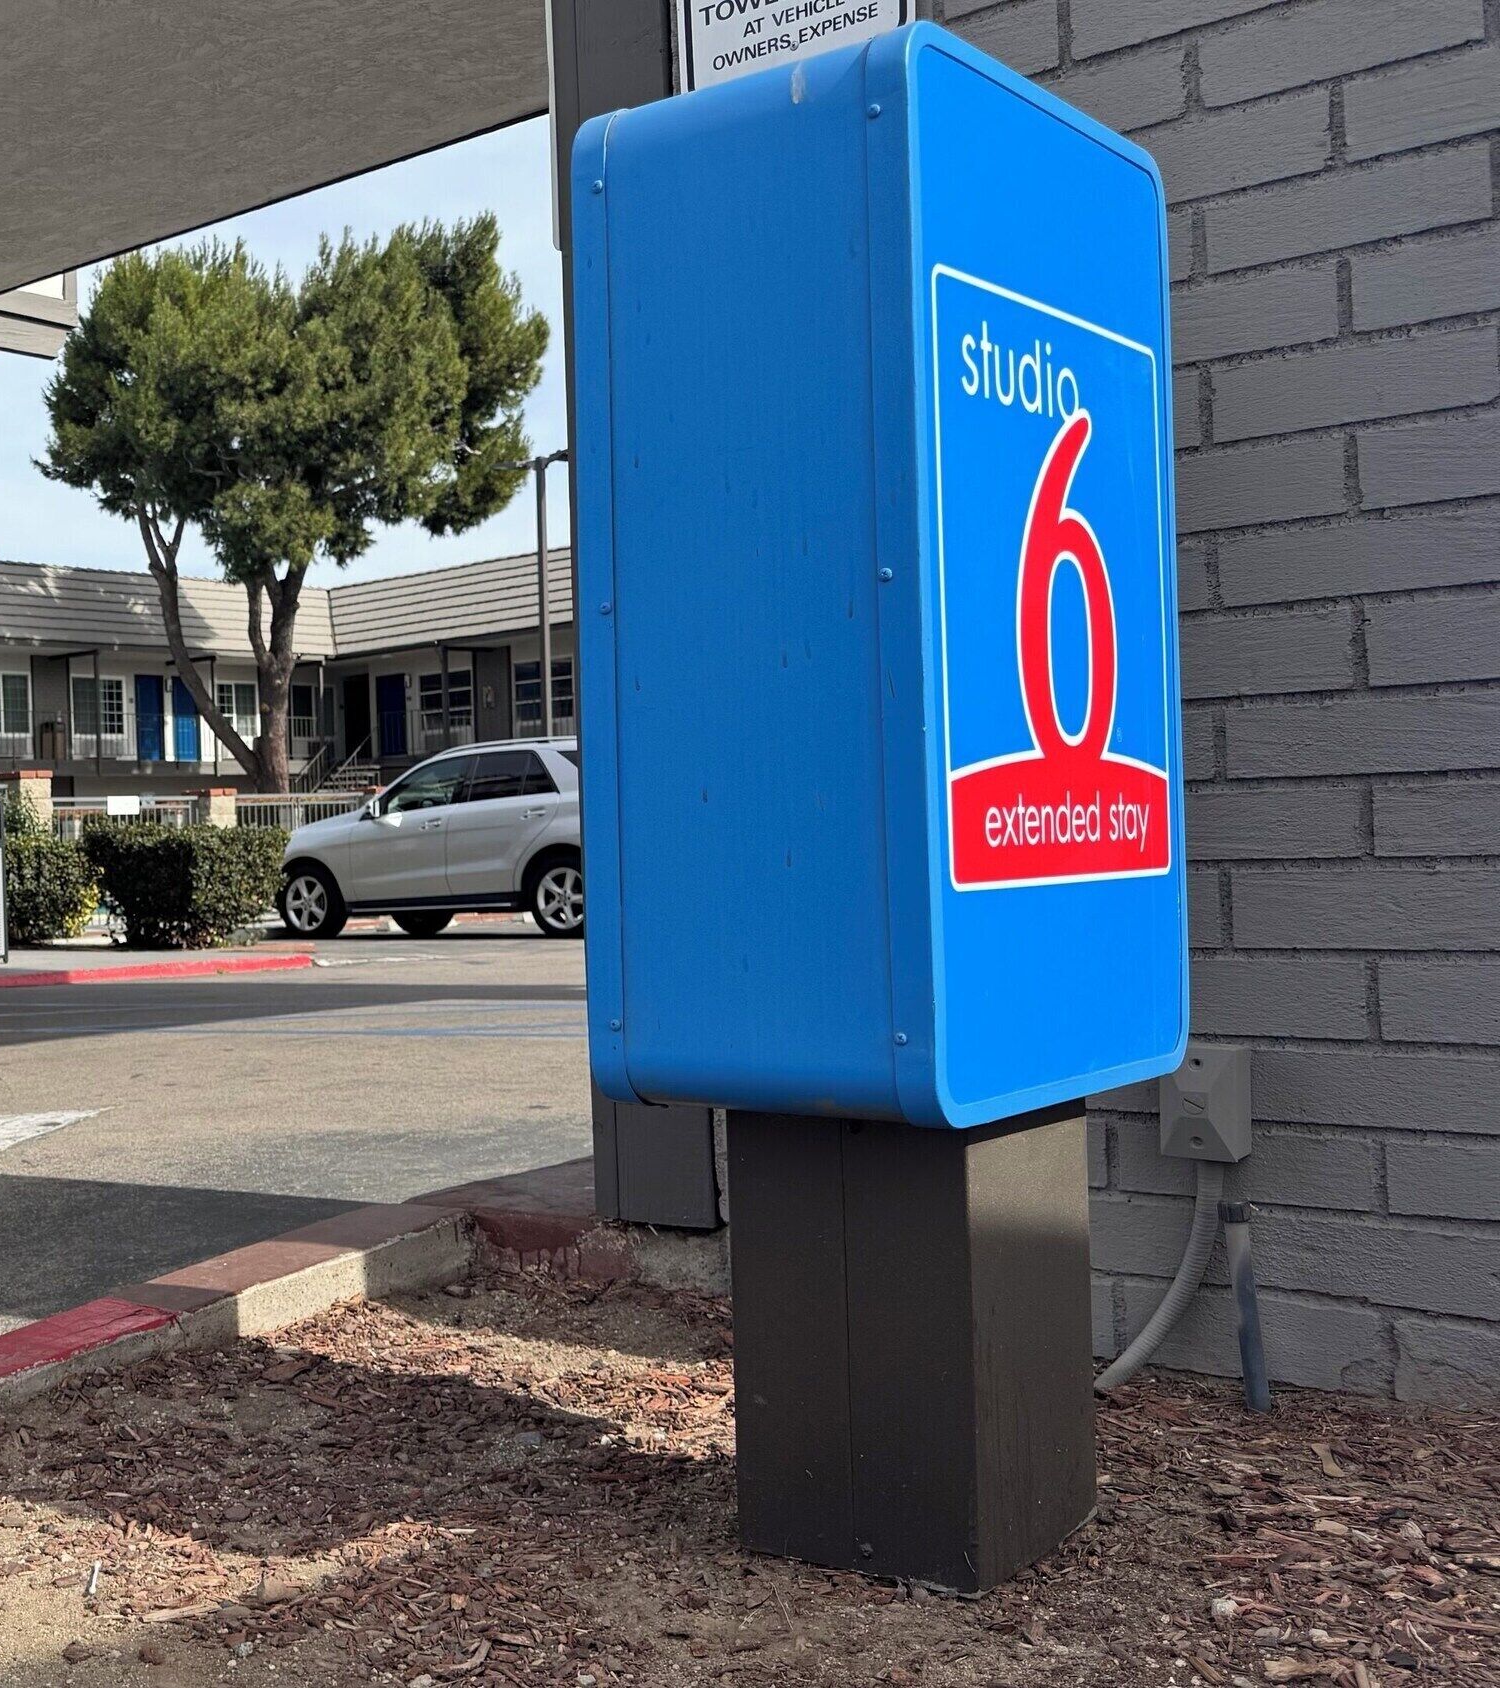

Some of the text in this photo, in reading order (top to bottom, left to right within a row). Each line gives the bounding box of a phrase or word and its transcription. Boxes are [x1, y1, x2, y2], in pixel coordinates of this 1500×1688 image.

[699, 0, 779, 26] TOW
[713, 2, 879, 71] OWNERS EXPENSE
[743, 17, 765, 38] AT
[961, 319, 1080, 420] studio
[1016, 407, 1118, 759] 6
[984, 789, 1150, 853] extended stay
